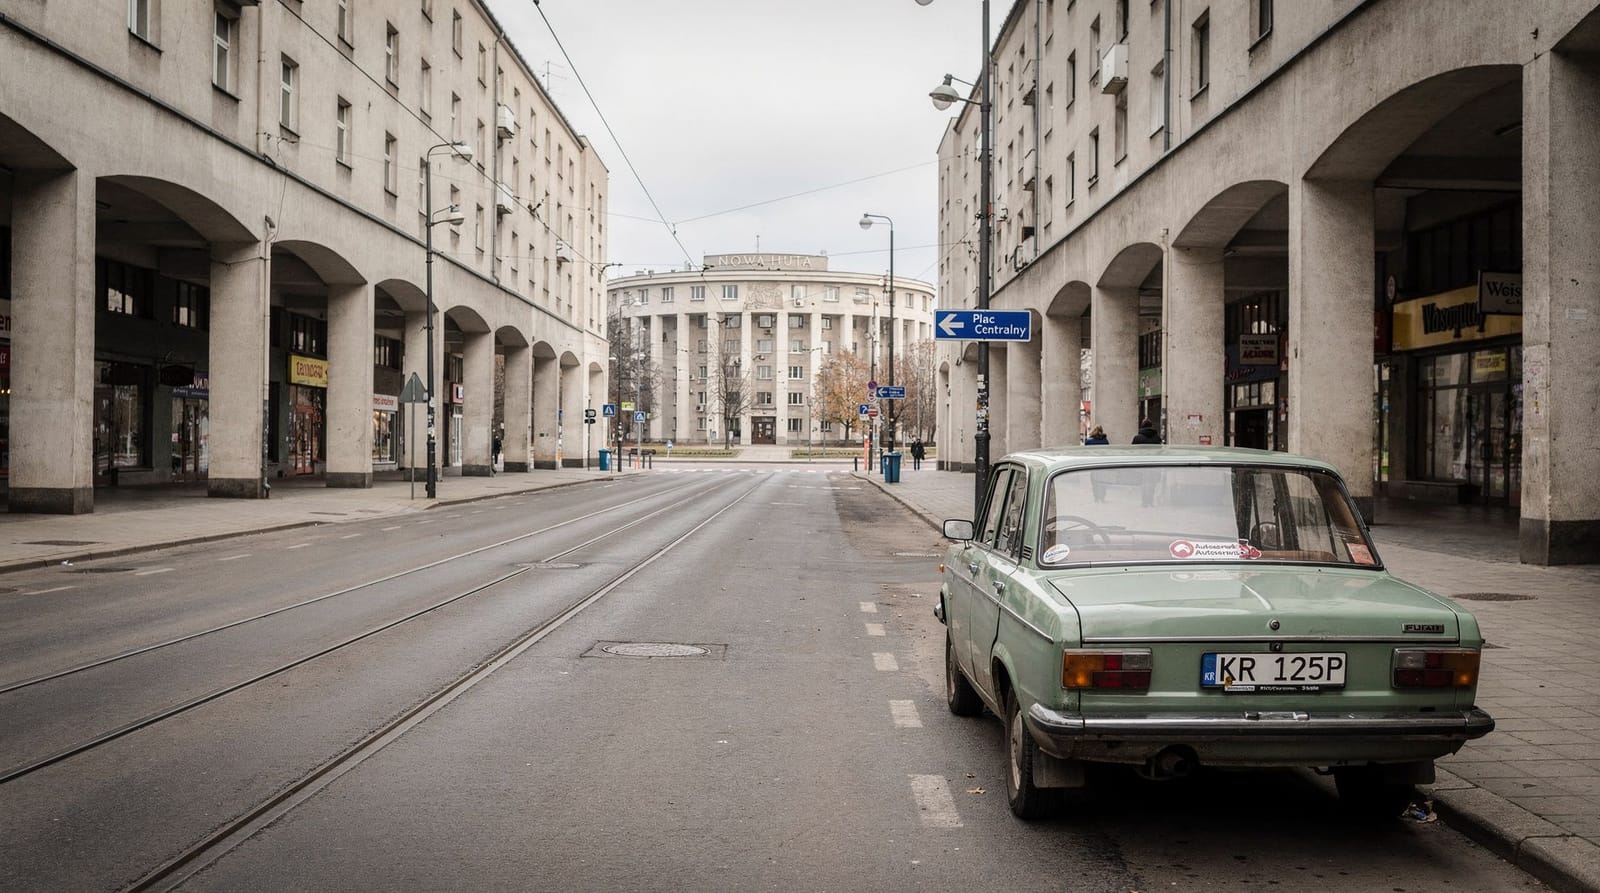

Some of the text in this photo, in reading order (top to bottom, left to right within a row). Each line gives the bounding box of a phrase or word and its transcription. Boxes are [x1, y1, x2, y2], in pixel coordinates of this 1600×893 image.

[718, 255, 812, 267] NOWA HUTA
[972, 313, 996, 324] Plac
[974, 324, 1027, 338] Centralny
[1219, 656, 1344, 682] KR 125P
[1204, 671, 1215, 681] KR
